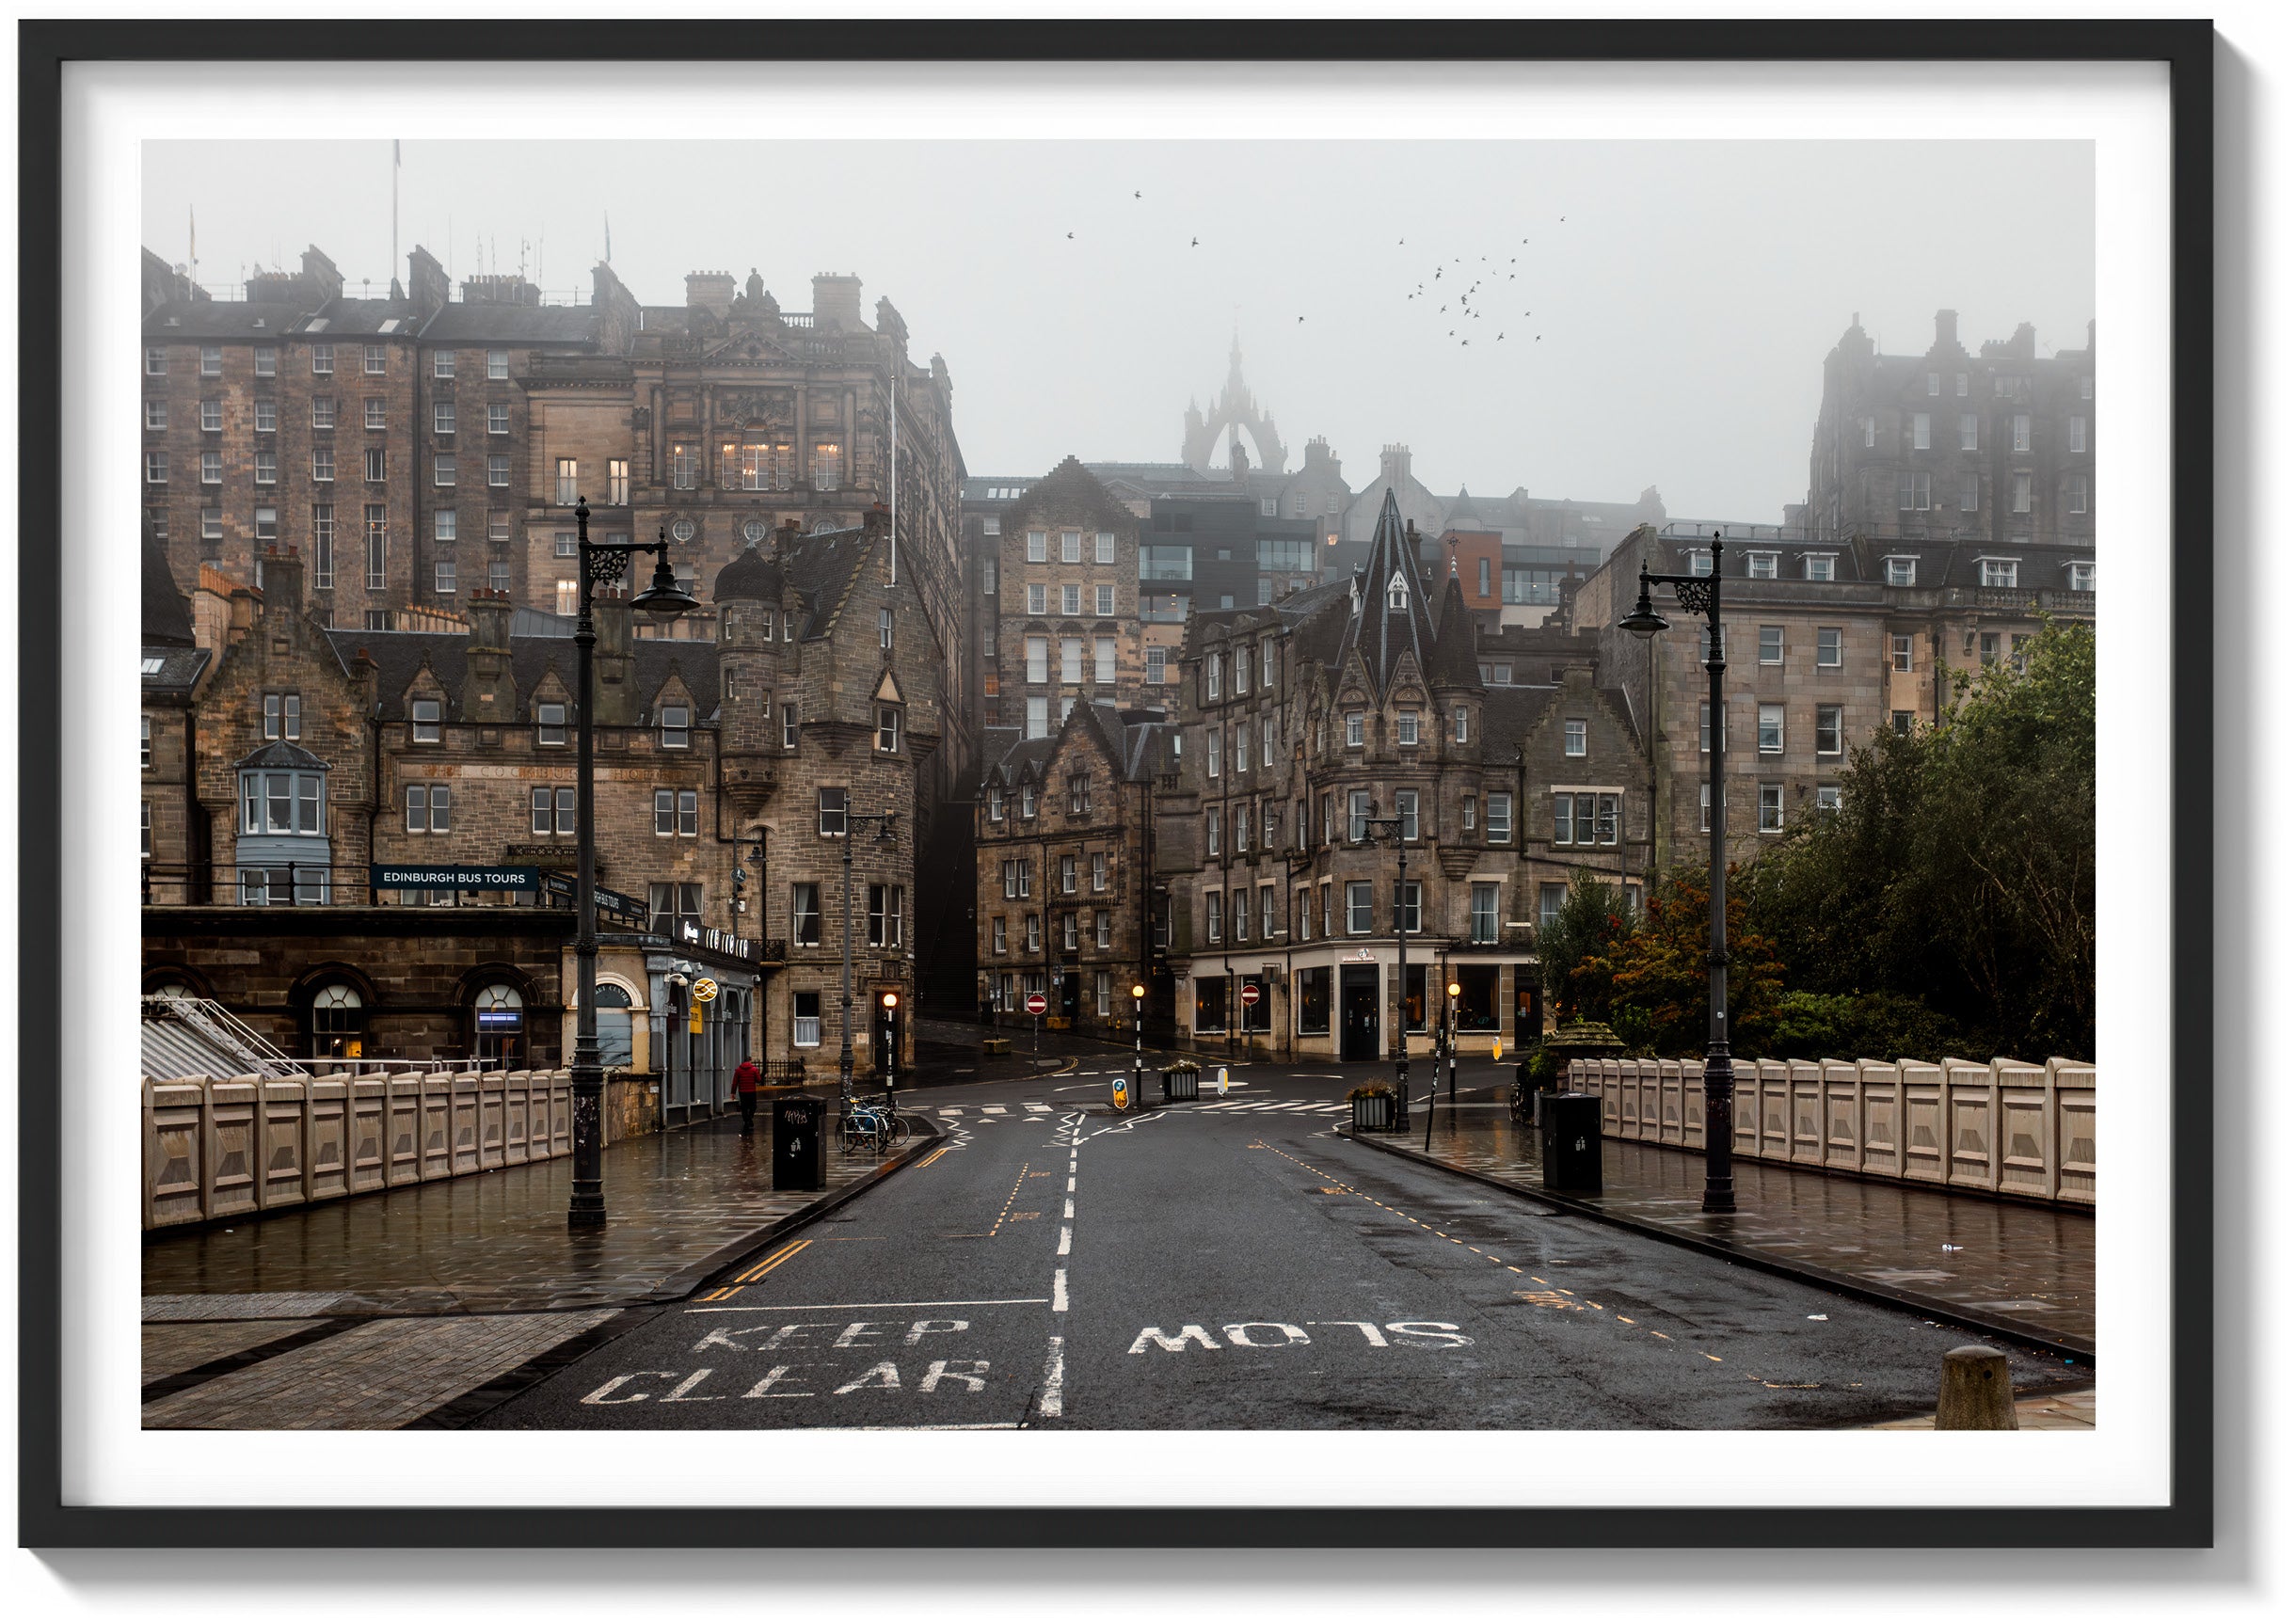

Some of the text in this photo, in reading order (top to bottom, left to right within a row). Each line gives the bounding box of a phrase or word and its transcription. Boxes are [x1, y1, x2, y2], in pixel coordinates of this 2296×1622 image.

[480, 766, 578, 779] COCKBUR
[383, 871, 526, 883] EDINBURGH BUS TOURS
[691, 1319, 970, 1353] KEEP
[1128, 1322, 1475, 1355] SLOW
[579, 1360, 991, 1405] CLEAR
